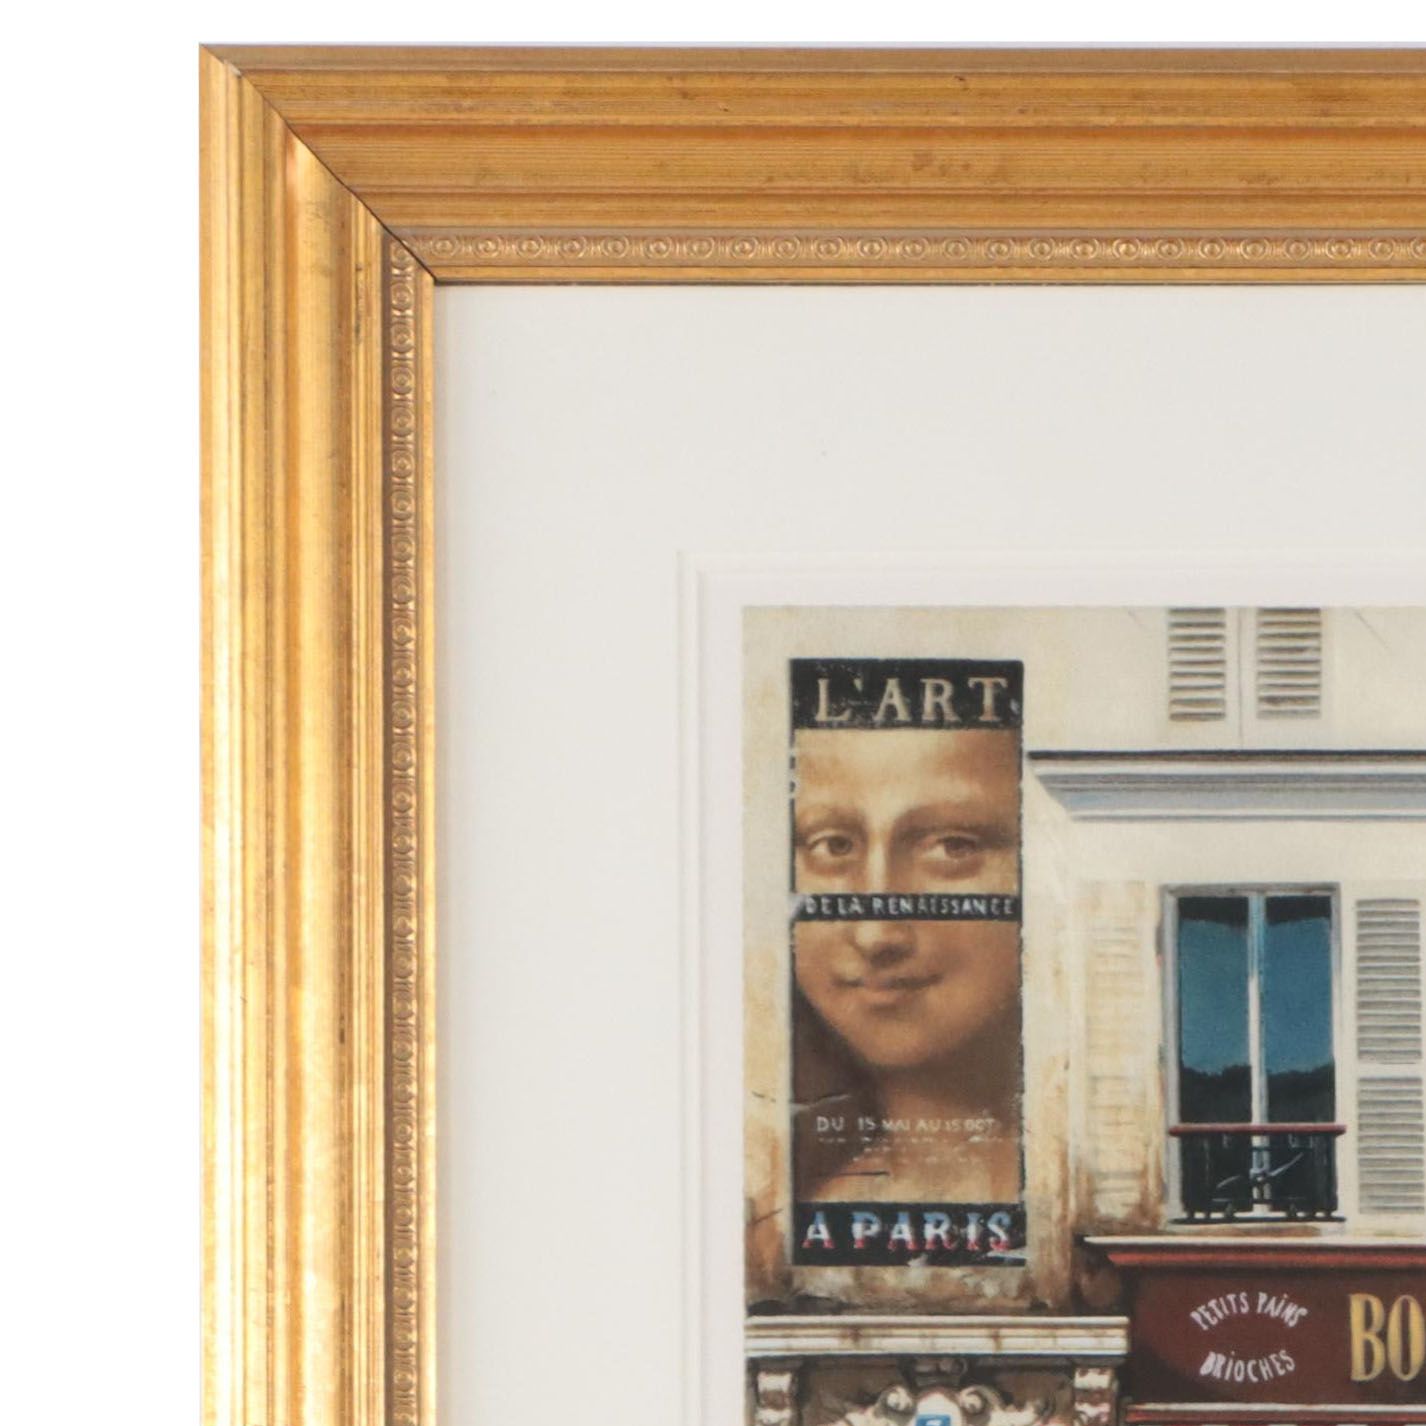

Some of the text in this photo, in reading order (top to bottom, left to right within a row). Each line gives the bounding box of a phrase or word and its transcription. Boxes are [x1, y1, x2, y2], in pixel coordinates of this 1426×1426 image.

[815, 676, 1008, 722] L'ART
[816, 1115, 845, 1132] DU
[802, 1210, 1013, 1251] A PARIS
